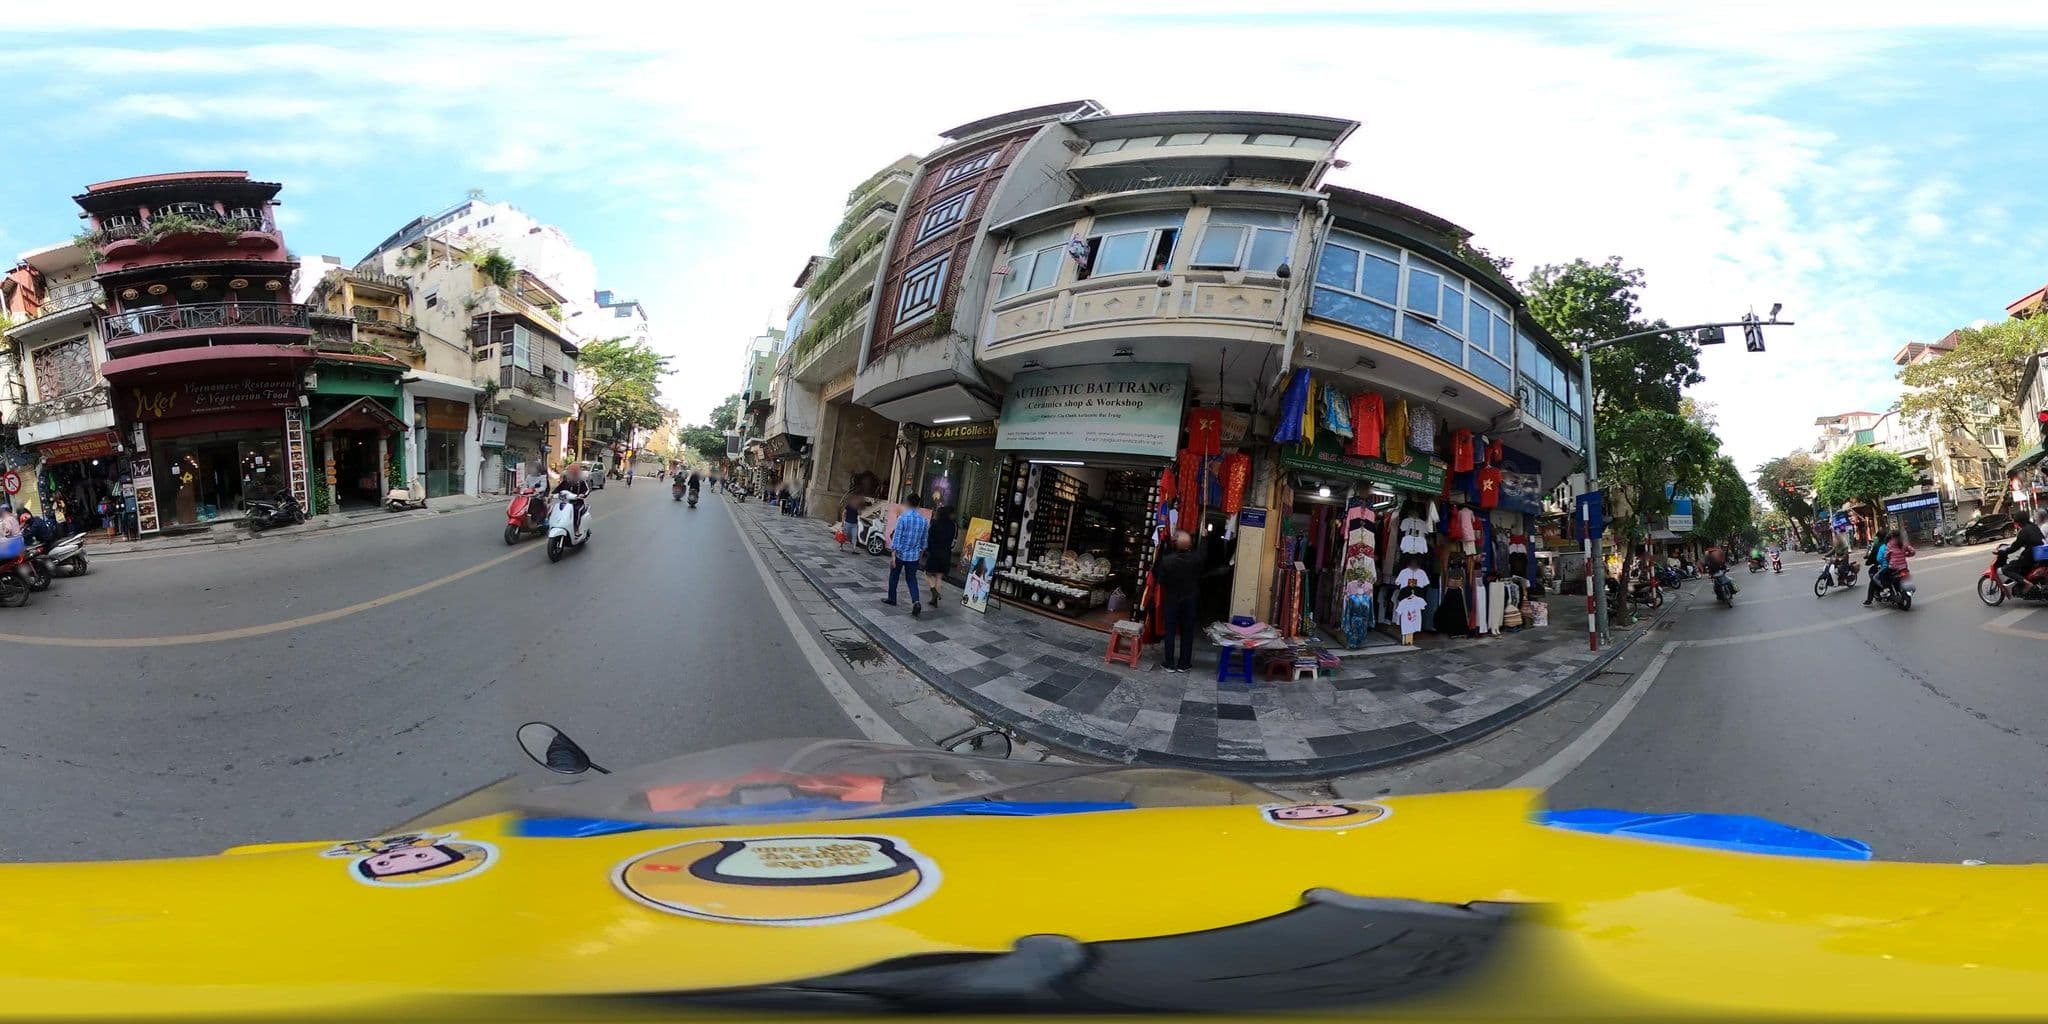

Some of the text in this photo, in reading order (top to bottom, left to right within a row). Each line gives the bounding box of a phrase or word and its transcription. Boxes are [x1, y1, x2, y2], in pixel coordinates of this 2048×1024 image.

[184, 378, 296, 394] Vietnamese Restaurant
[1014, 381, 1171, 399] AUTHENTIC BAT TRANG
[207, 392, 261, 406] Vegetarian
[262, 389, 289, 400] Food
[1028, 398, 1143, 409] Ceramics shop & Workshop
[944, 427, 959, 437] Art
